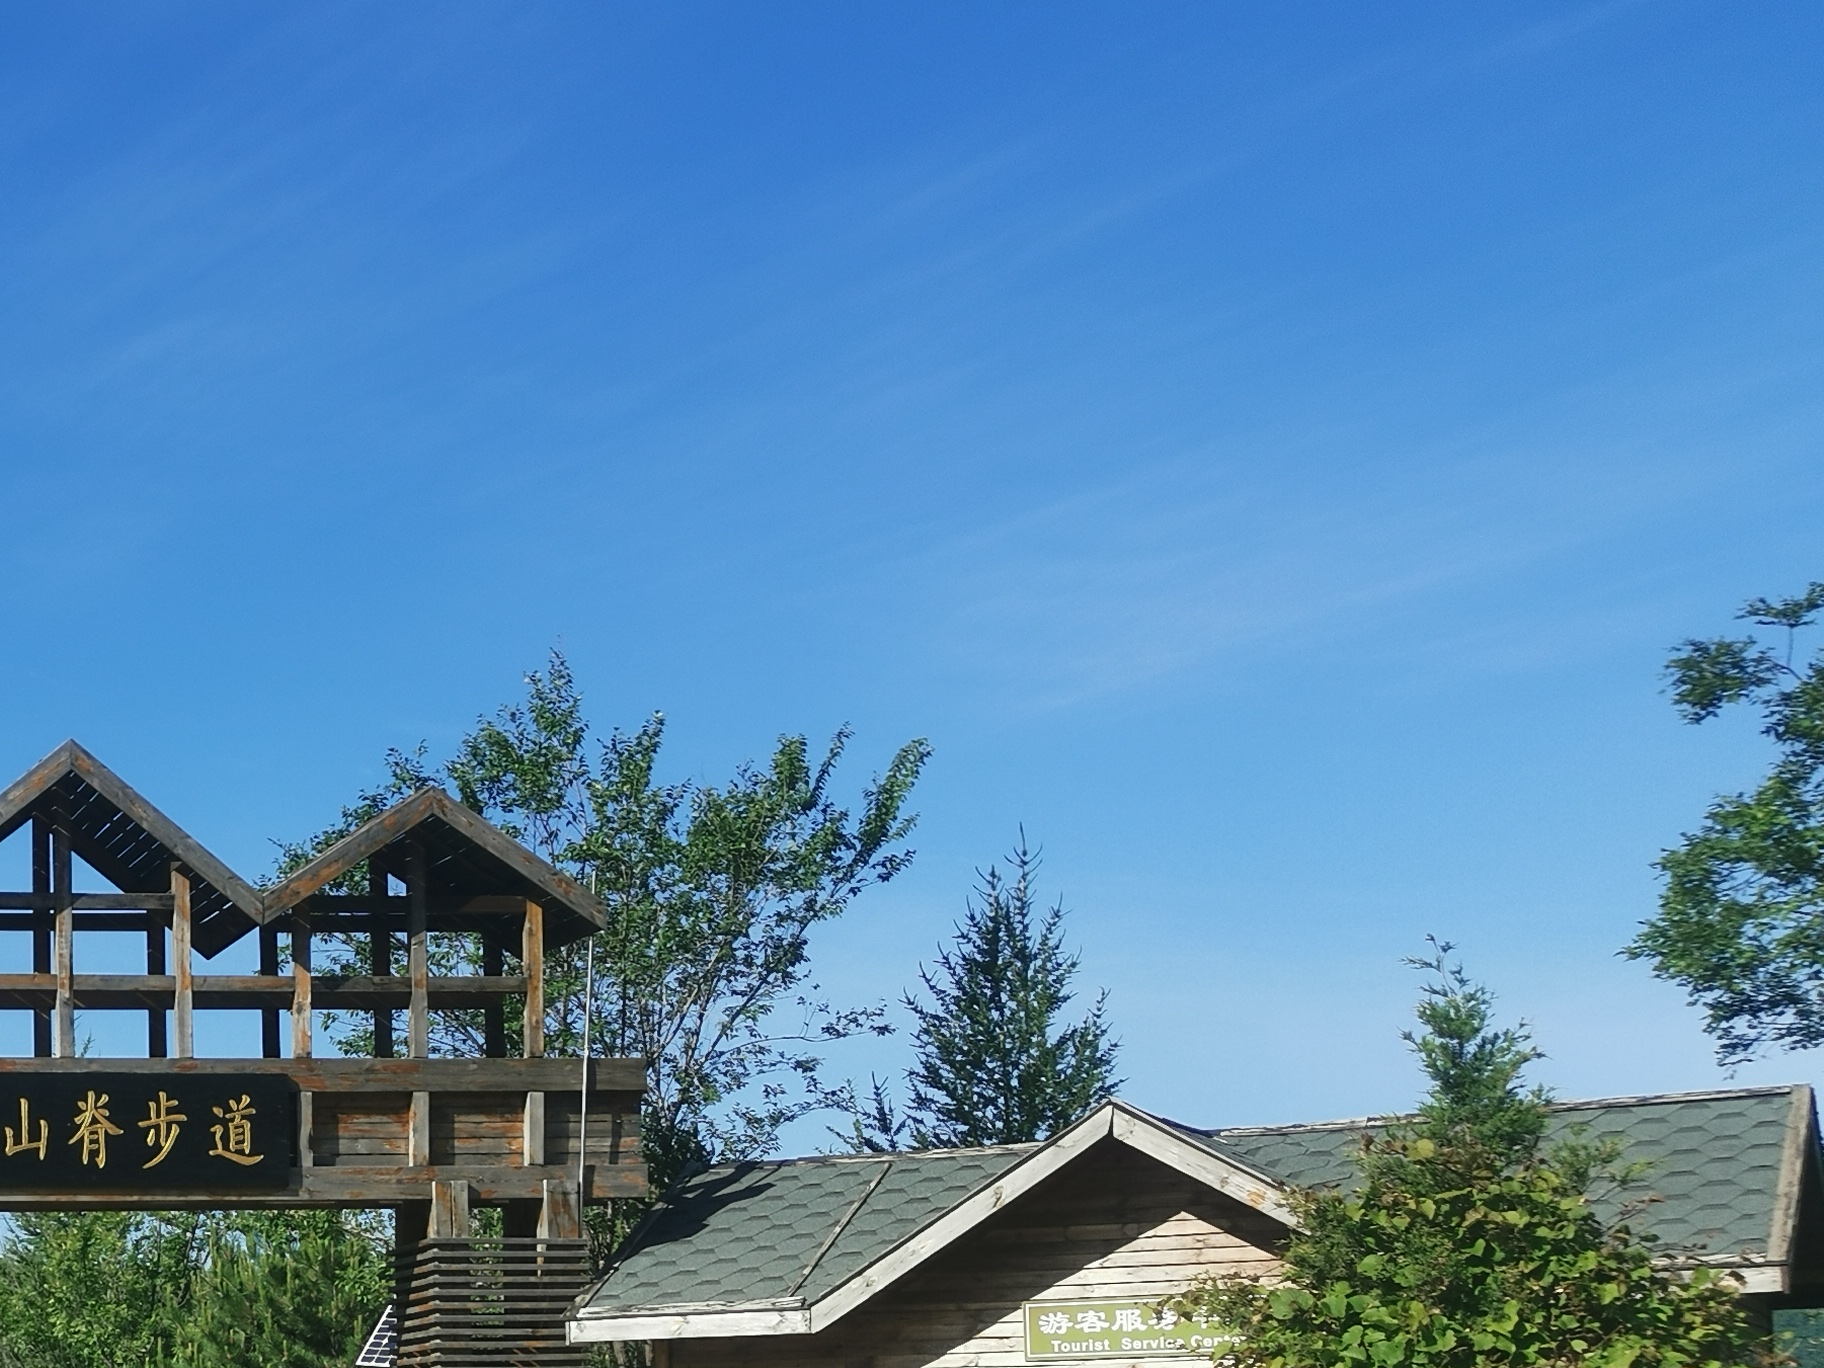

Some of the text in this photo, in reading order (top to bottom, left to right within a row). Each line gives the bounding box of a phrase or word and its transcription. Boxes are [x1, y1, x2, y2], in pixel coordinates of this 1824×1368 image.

[1038, 1306, 1231, 1335] 游客服务中
[1051, 1339, 1110, 1353] Tourist
[1121, 1335, 1185, 1351] Service
